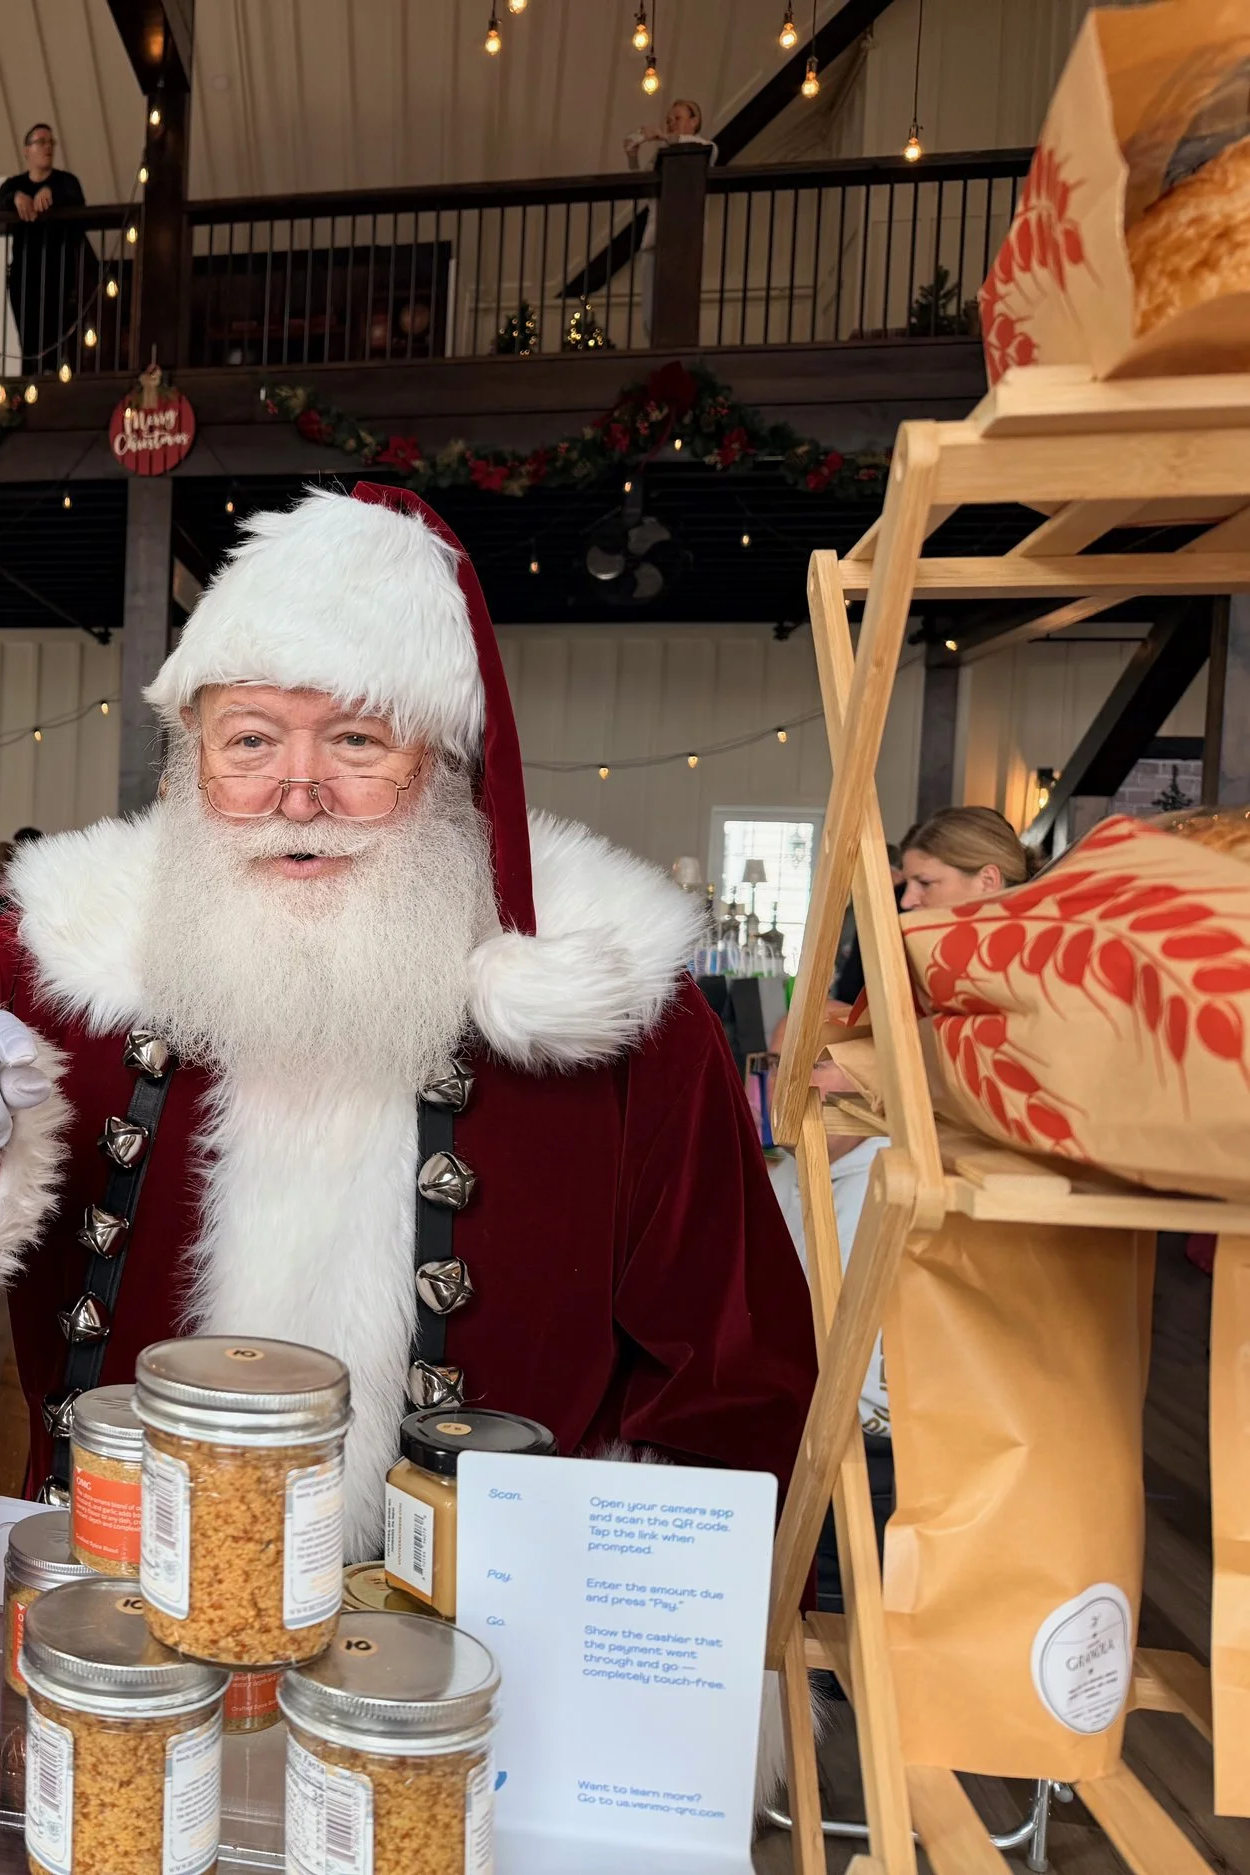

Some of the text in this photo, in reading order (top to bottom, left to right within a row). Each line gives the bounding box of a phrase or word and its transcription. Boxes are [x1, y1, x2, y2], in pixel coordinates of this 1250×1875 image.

[124, 408, 178, 437] Merry
[114, 431, 189, 455] Christmas
[489, 1488, 523, 1500] Scan.
[590, 1496, 734, 1520] Open your camera app
[590, 1512, 731, 1532] and scan the QR code.
[589, 1526, 695, 1544] Tap the link when
[588, 1541, 653, 1555] prompted.
[487, 1569, 512, 1583] Pay.
[586, 1578, 724, 1600] Enter the amount due
[586, 1593, 608, 1604] and
[611, 1596, 646, 1608] press
[486, 1615, 505, 1627] Go.
[584, 1625, 722, 1648] Show the cashier that
[584, 1639, 698, 1659] the payment went
[584, 1653, 633, 1668] through
[636, 1658, 659, 1670] and
[662, 1661, 679, 1672] go
[582, 1667, 726, 1690] completely touch-free.
[578, 1779, 702, 1803] Want to learn more?
[577, 1793, 725, 1819] Go to us.venmo-qrc.com
